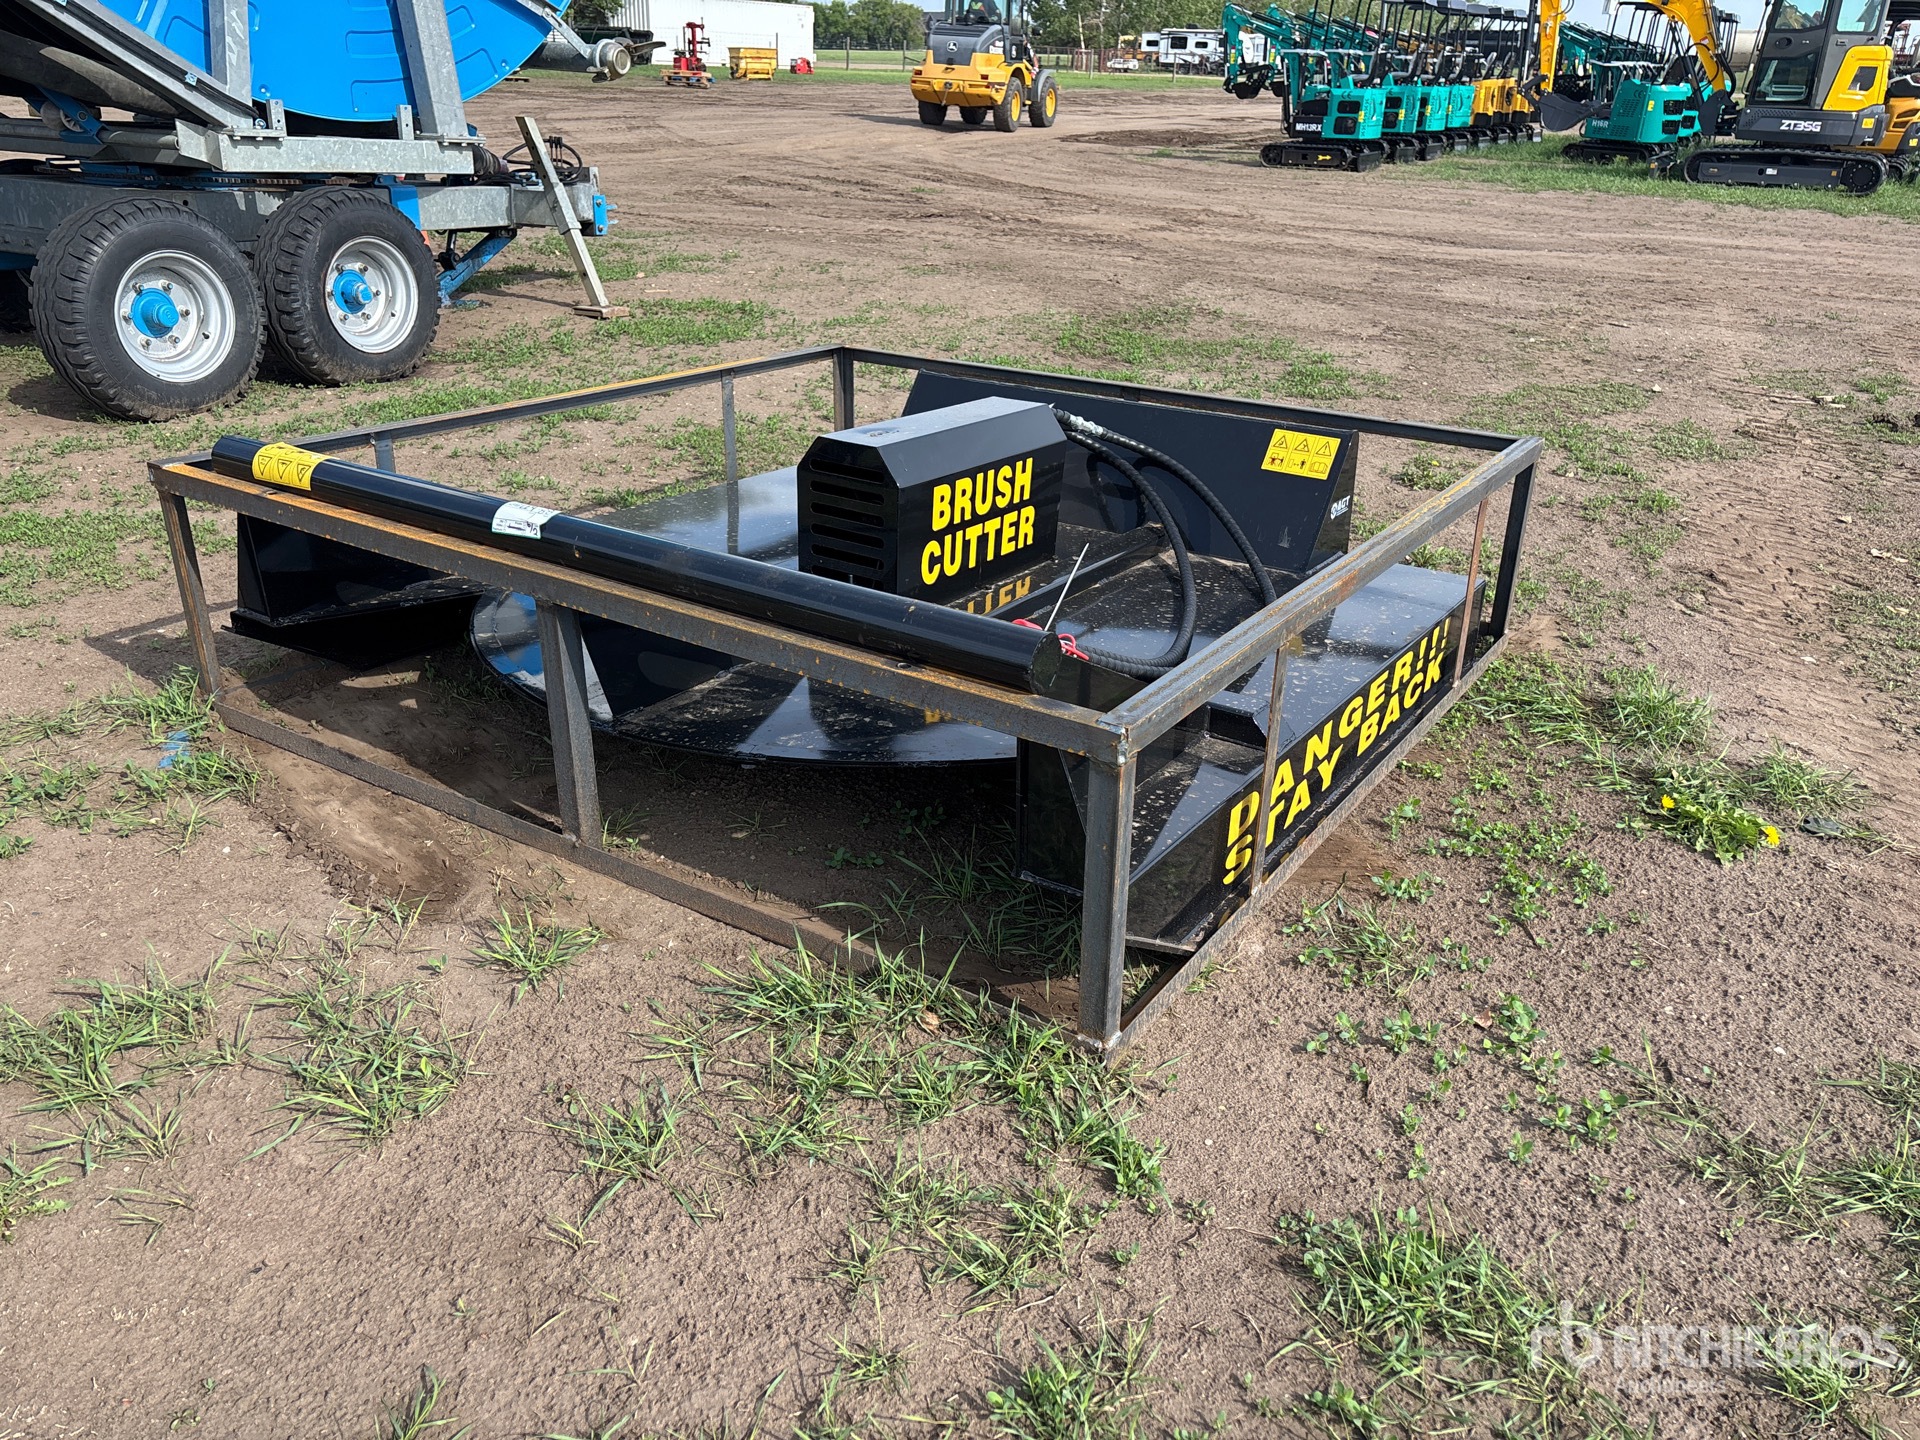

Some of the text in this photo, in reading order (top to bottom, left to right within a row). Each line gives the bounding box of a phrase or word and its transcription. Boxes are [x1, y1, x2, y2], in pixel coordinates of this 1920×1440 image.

[932, 457, 1033, 532] BRUSH
[921, 505, 1036, 586] CUTTER
[1222, 650, 1446, 886] STAY BACK
